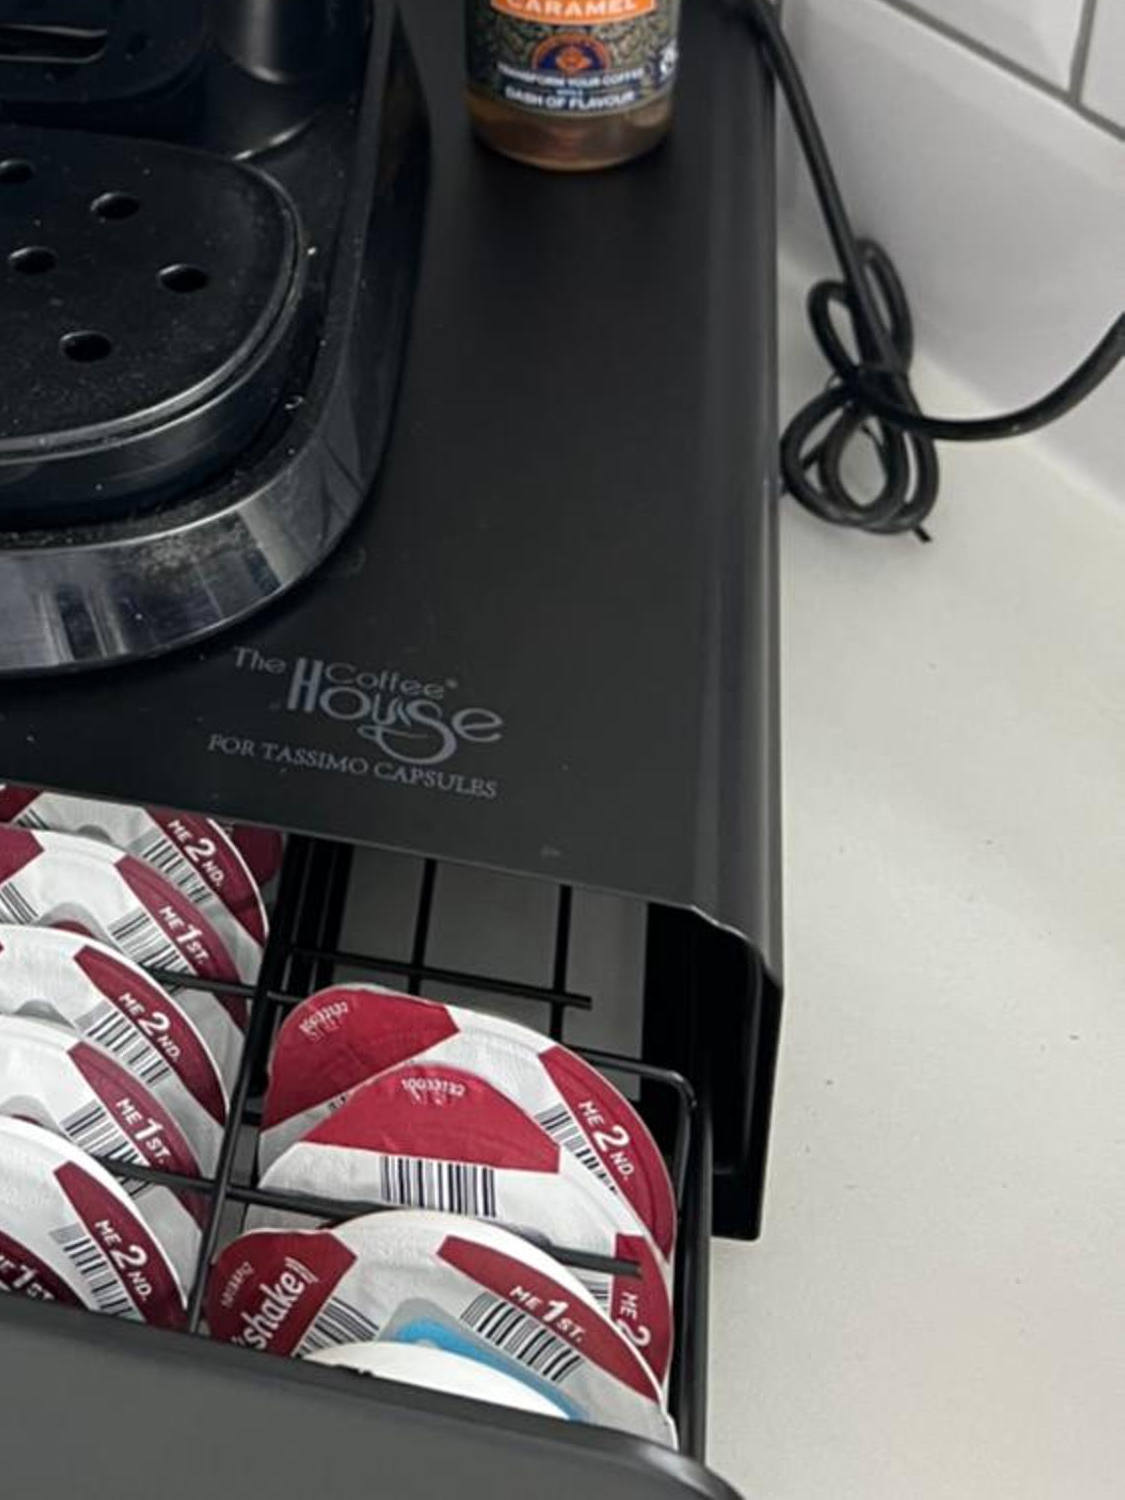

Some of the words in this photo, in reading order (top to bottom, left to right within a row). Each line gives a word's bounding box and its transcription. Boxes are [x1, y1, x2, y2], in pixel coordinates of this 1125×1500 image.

[233, 646, 287, 674] The
[208, 732, 255, 757] FOR
[261, 741, 369, 776] TASSIMO
[373, 762, 498, 799] CAPSULES
[166, 819, 190, 844] ME
[159, 904, 184, 928] ME
[118, 991, 144, 1017] ME
[115, 1097, 144, 1125] ME
[577, 1099, 604, 1127] ME
[94, 1217, 121, 1248] ME
[240, 1271, 306, 1351] shake
[508, 1285, 539, 1313] ME
